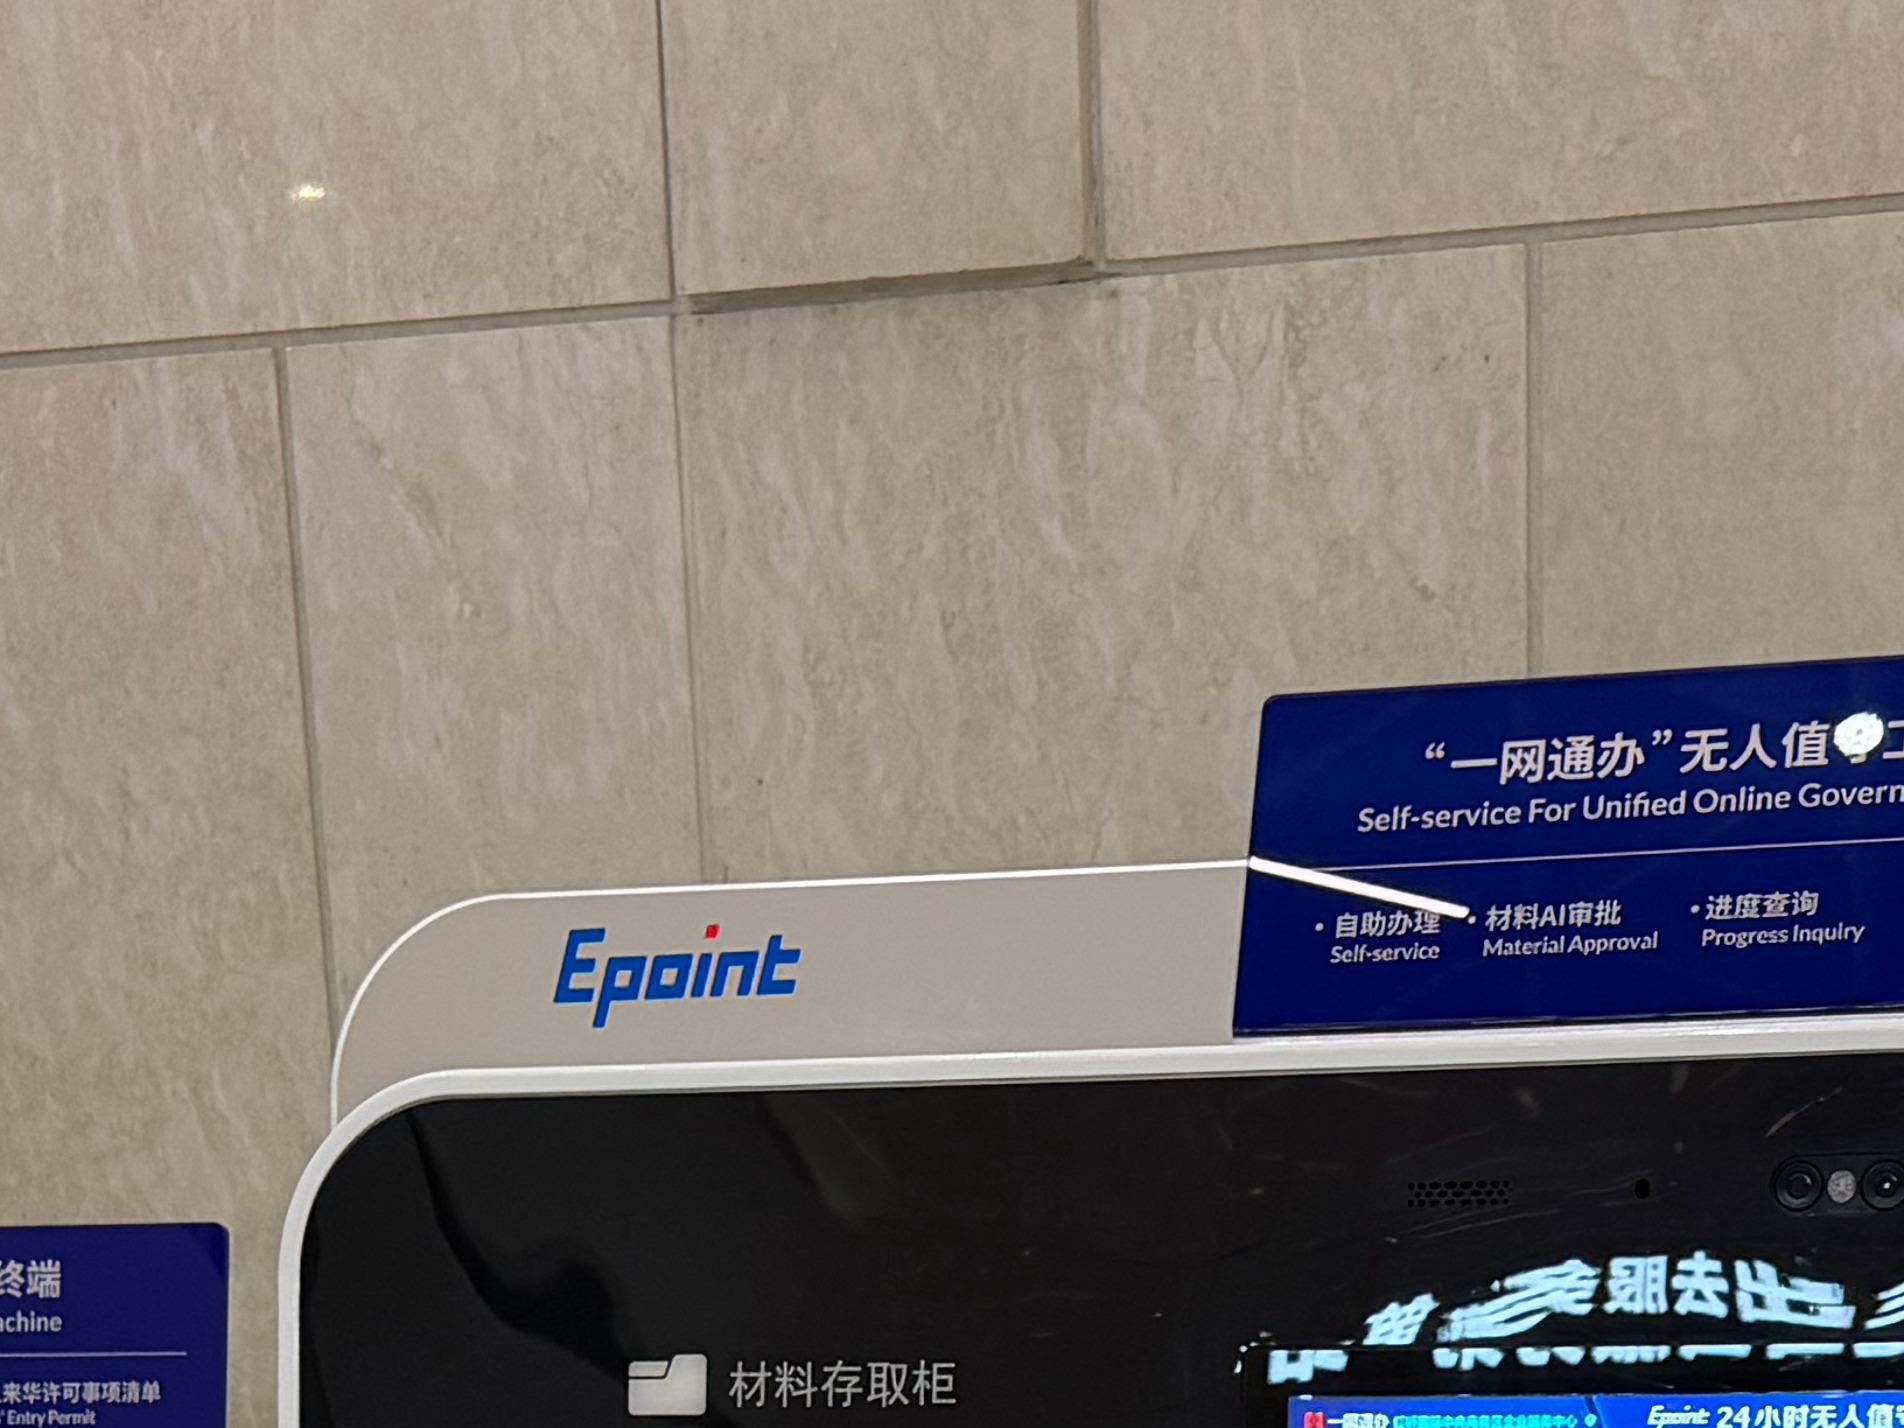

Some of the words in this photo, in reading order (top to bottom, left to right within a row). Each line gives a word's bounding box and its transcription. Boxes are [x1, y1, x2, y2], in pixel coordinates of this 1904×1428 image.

[1357, 803, 1523, 834] Self-service
[1527, 798, 1575, 826] For
[1582, 790, 1687, 821] Unified
[1692, 785, 1792, 815] Online
[1484, 898, 1622, 932] 材料AI审批
[1704, 891, 1820, 921] 进度查询
[1334, 908, 1442, 939] 自助办理
[1700, 927, 1789, 949] Progress
[1792, 922, 1865, 947] Inquiry
[1328, 942, 1441, 965] Self-service
[1481, 935, 1565, 958] Material
[1567, 931, 1659, 957] Approval
[552, 924, 802, 1029] Epoint
[728, 1359, 958, 1408] 材料存取柜
[47, 1408, 97, 1427] Permit
